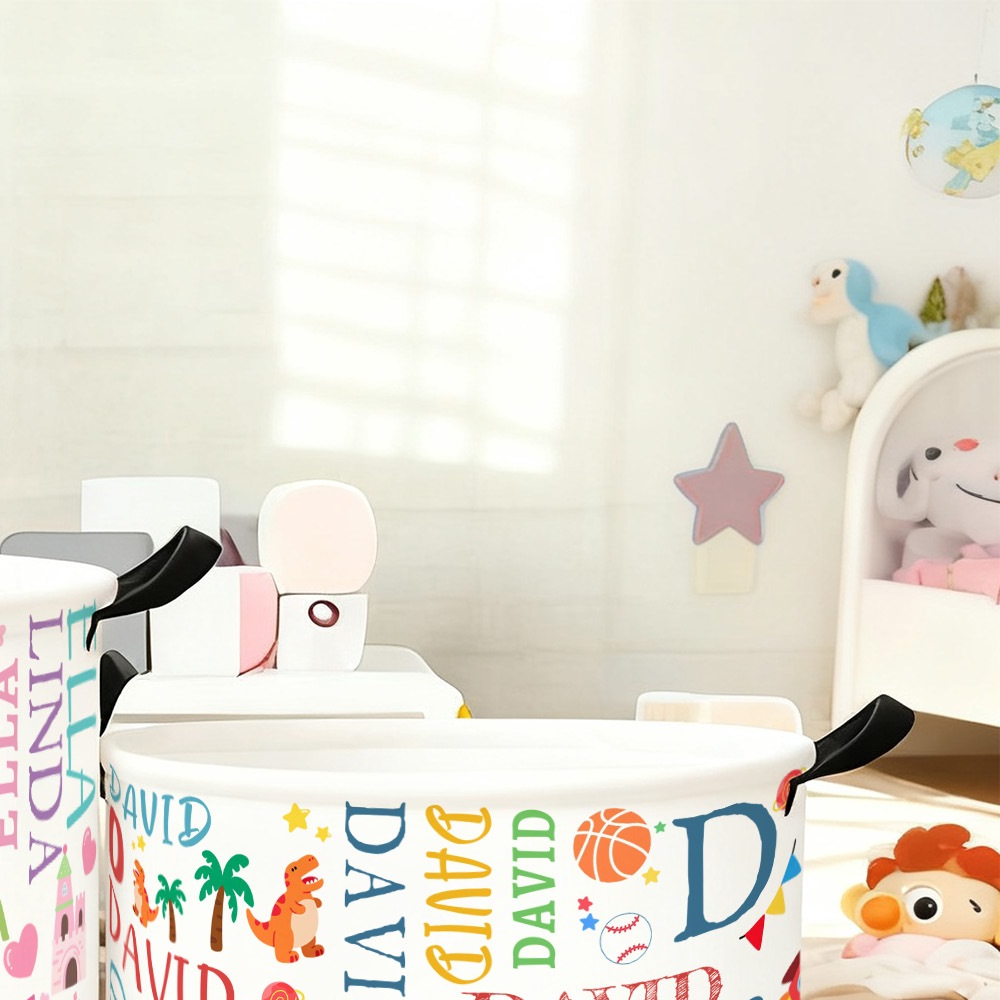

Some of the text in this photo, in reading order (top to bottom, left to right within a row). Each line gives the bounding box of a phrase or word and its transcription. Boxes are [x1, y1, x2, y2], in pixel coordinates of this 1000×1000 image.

[29, 609, 63, 885] LINDA
[66, 599, 96, 829] ELLA
[109, 763, 211, 847] DAVID
[512, 809, 556, 969] DAVID
[672, 802, 777, 943] D
[423, 805, 492, 985] DAVID
